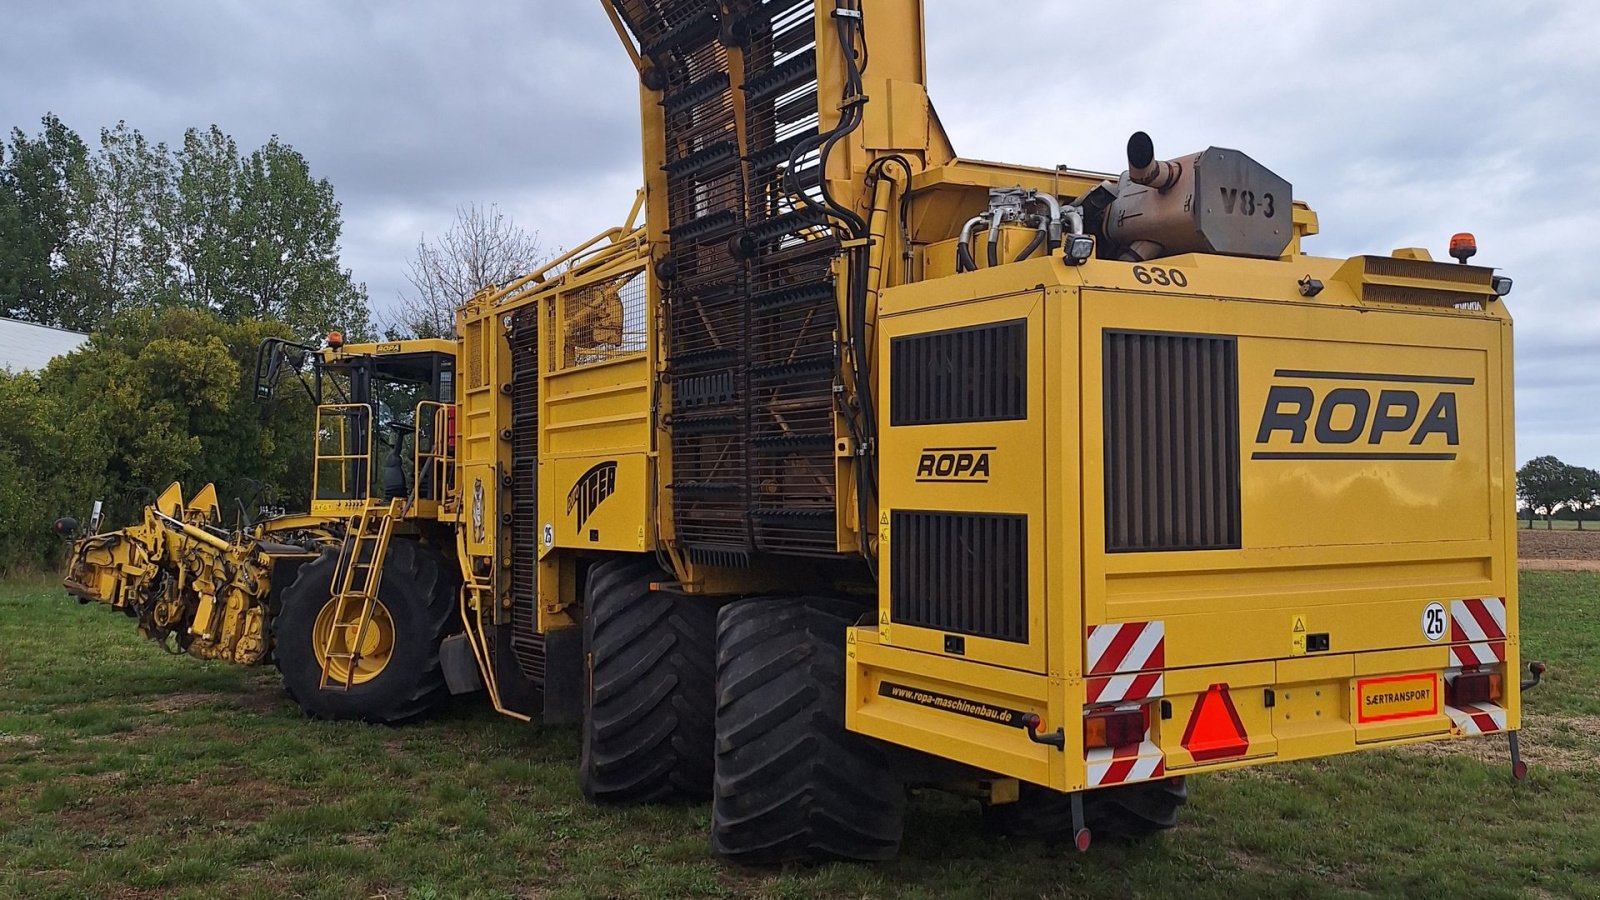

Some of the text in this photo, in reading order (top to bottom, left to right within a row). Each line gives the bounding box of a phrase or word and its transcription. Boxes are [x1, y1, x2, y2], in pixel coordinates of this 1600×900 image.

[1220, 187, 1275, 218] V8-3
[1132, 265, 1188, 288] 630
[1255, 385, 1460, 446] ROPA
[916, 453, 990, 477] ROPA
[567, 461, 618, 536] TIGER
[1427, 608, 1444, 635] 25
[891, 686, 1012, 722] www.ropa-maschinenbau.de
[1366, 689, 1430, 706] SÆRTRANSPORT
